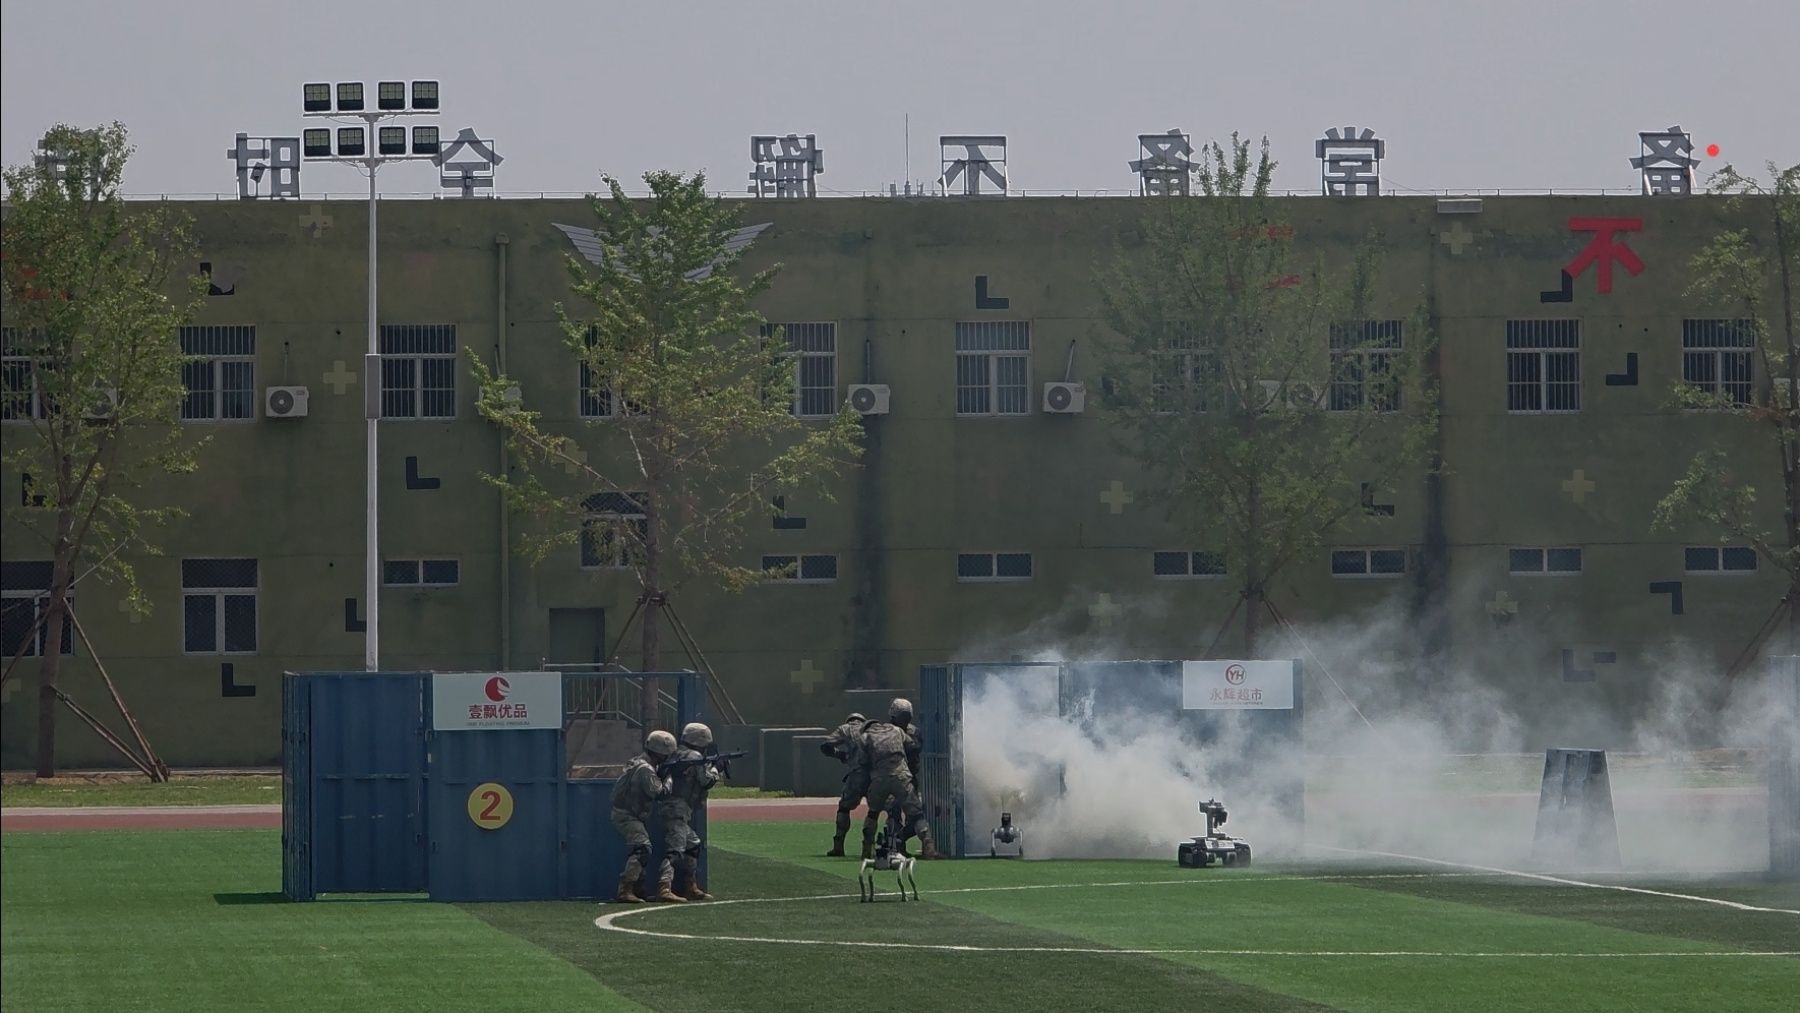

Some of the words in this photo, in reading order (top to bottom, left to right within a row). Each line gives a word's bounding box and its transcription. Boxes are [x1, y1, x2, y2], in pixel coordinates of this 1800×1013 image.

[1564, 217, 1645, 294] 不
[469, 704, 528, 719] 壹飘优品
[479, 790, 501, 821] 2
